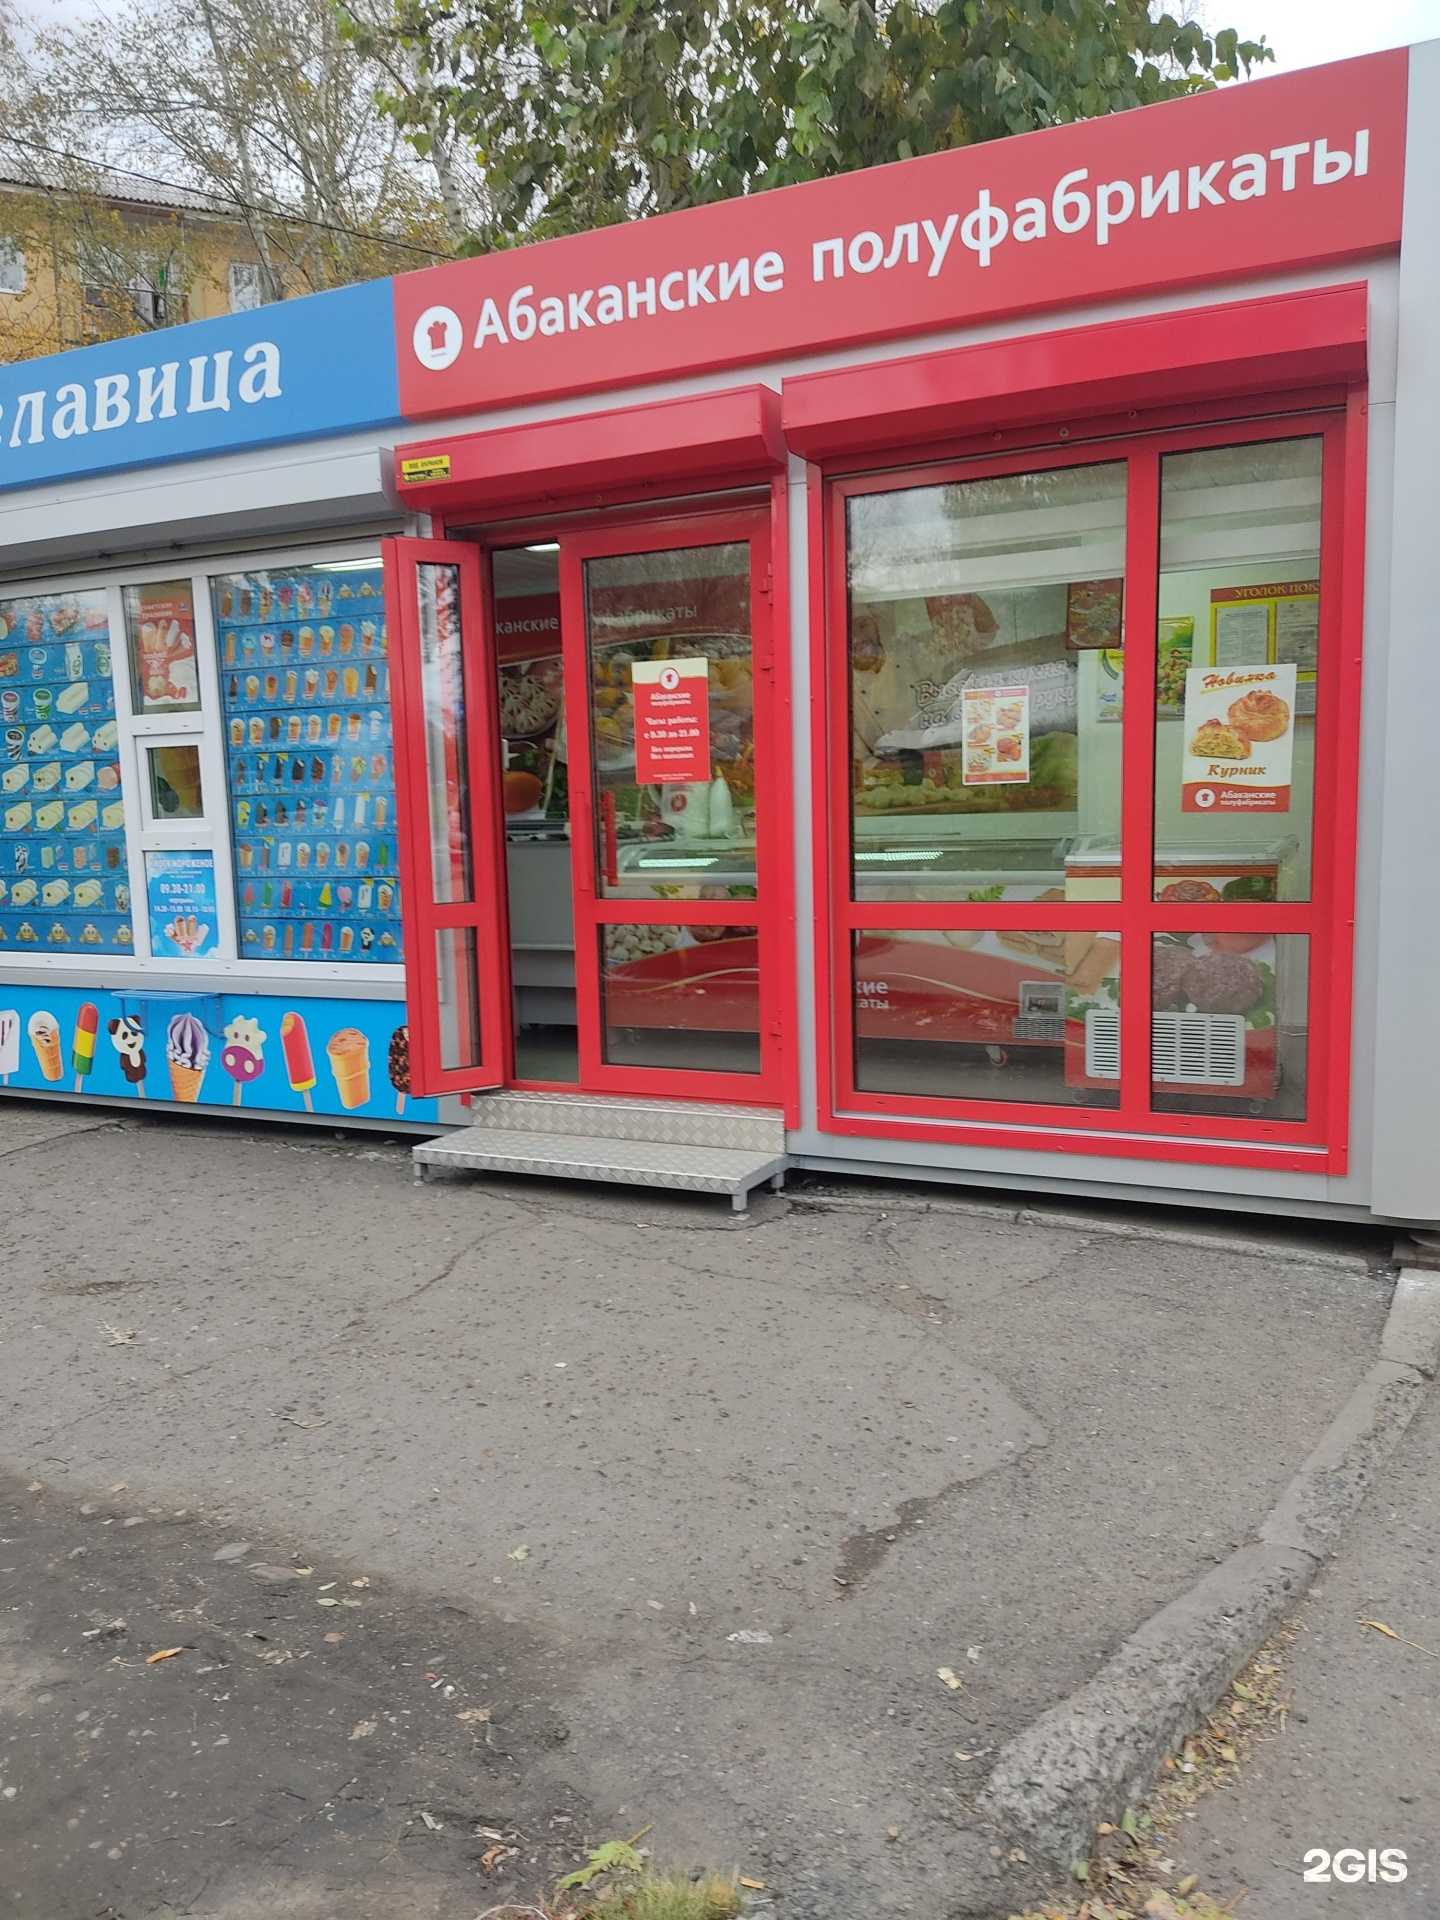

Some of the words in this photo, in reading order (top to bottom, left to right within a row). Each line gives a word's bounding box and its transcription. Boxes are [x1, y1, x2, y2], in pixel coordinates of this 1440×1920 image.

[473, 250, 785, 349] Абаканские
[812, 128, 1370, 282] полуфабрикаты
[0, 341, 282, 448] лавица
[1233, 584, 1287, 598] УГОЛОК
[1202, 671, 1277, 689] Новинка
[1208, 764, 1267, 779] Курник
[1220, 790, 1277, 800] Абаканские
